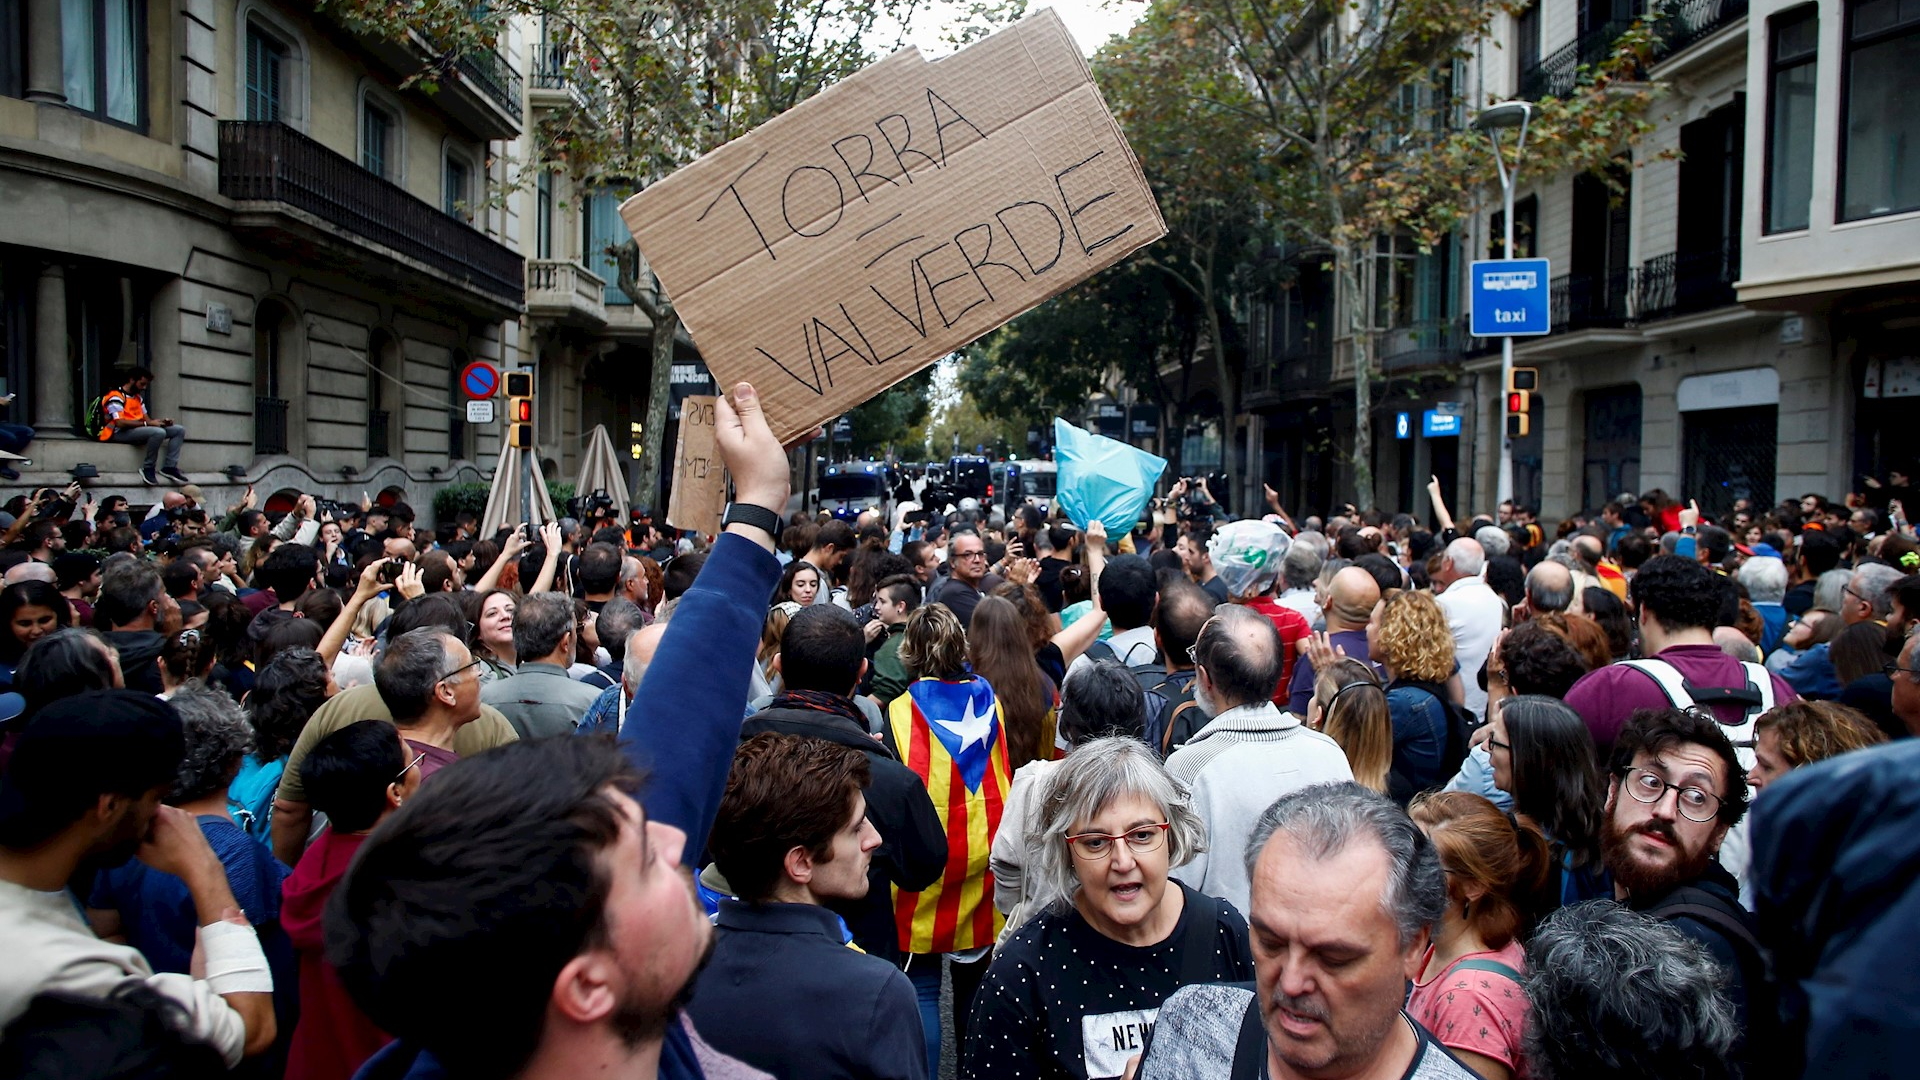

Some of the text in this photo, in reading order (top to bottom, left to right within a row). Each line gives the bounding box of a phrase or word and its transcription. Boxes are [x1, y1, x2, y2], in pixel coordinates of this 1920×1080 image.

[697, 87, 988, 260] TORRA
[755, 151, 1134, 395] VALVERDE
[1495, 307, 1526, 324] taxi
[1112, 1022, 1153, 1052] NEW
